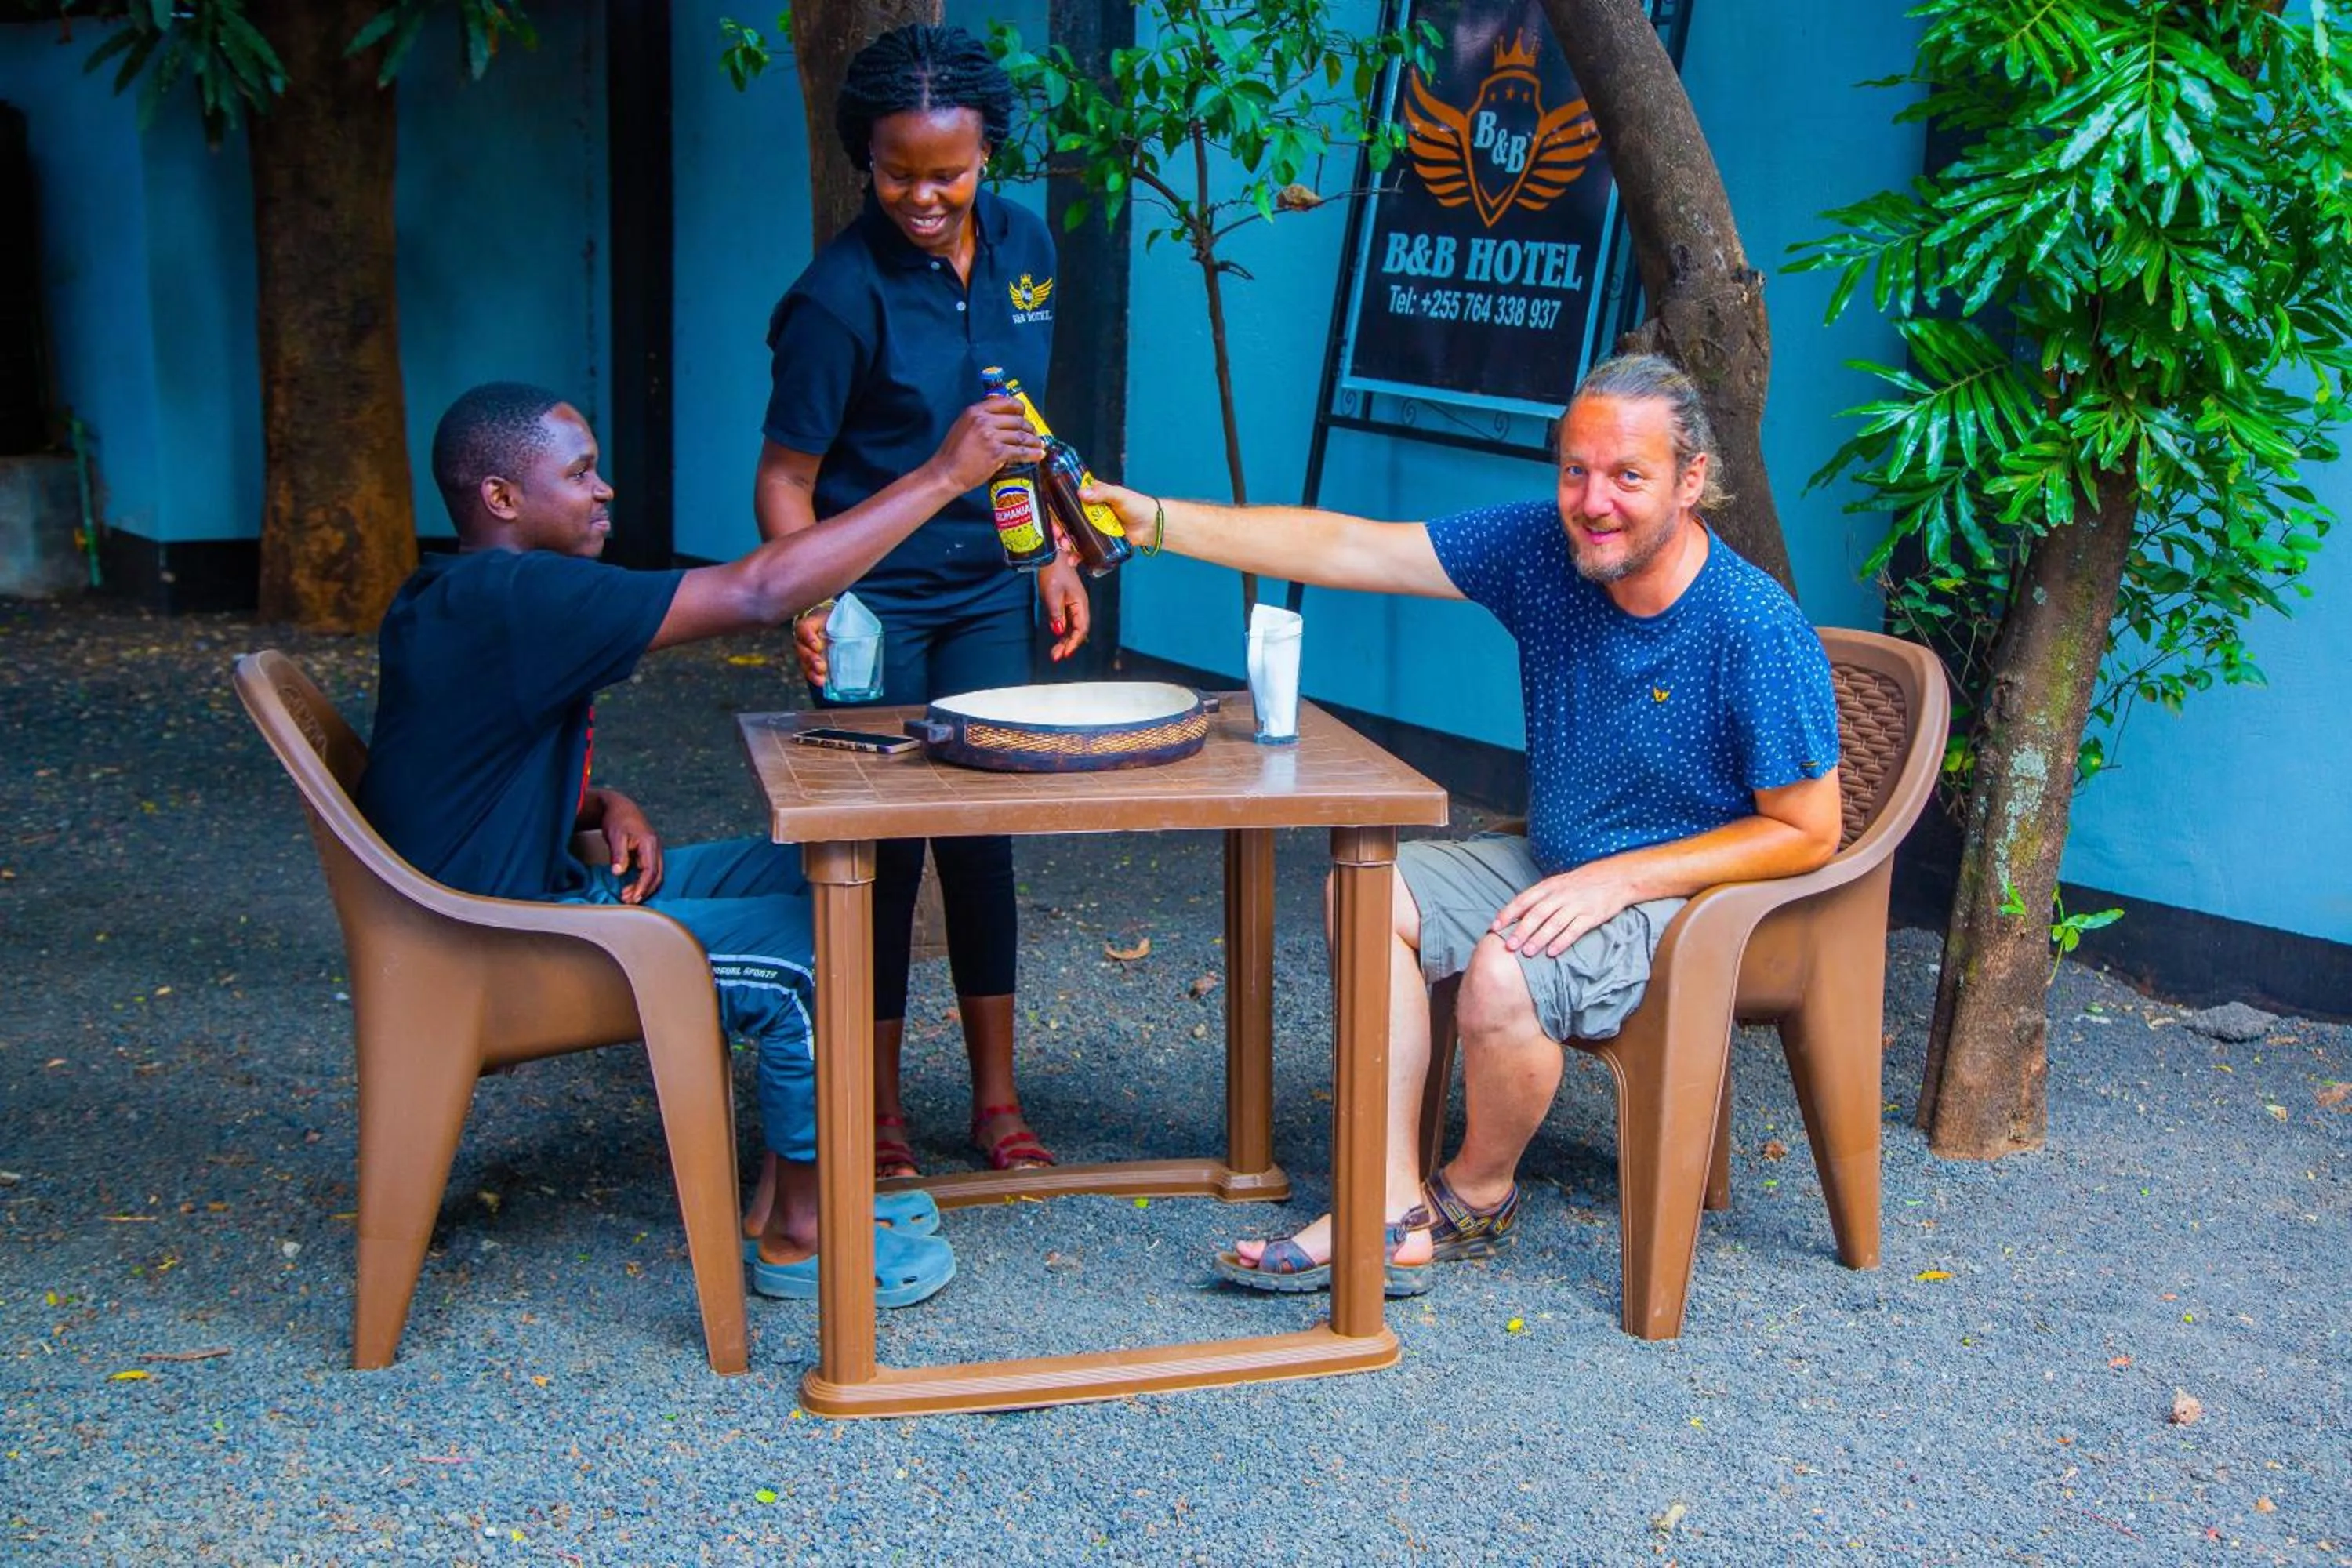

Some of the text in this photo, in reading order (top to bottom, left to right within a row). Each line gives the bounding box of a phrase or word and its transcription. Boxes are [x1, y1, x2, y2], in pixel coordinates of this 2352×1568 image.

[1473, 111, 1526, 173] B&B
[1382, 232, 1583, 291] B&B HOTEL
[1389, 285, 1562, 329] Tel: +255 764 338 937
[742, 967, 779, 979] SPORTS
